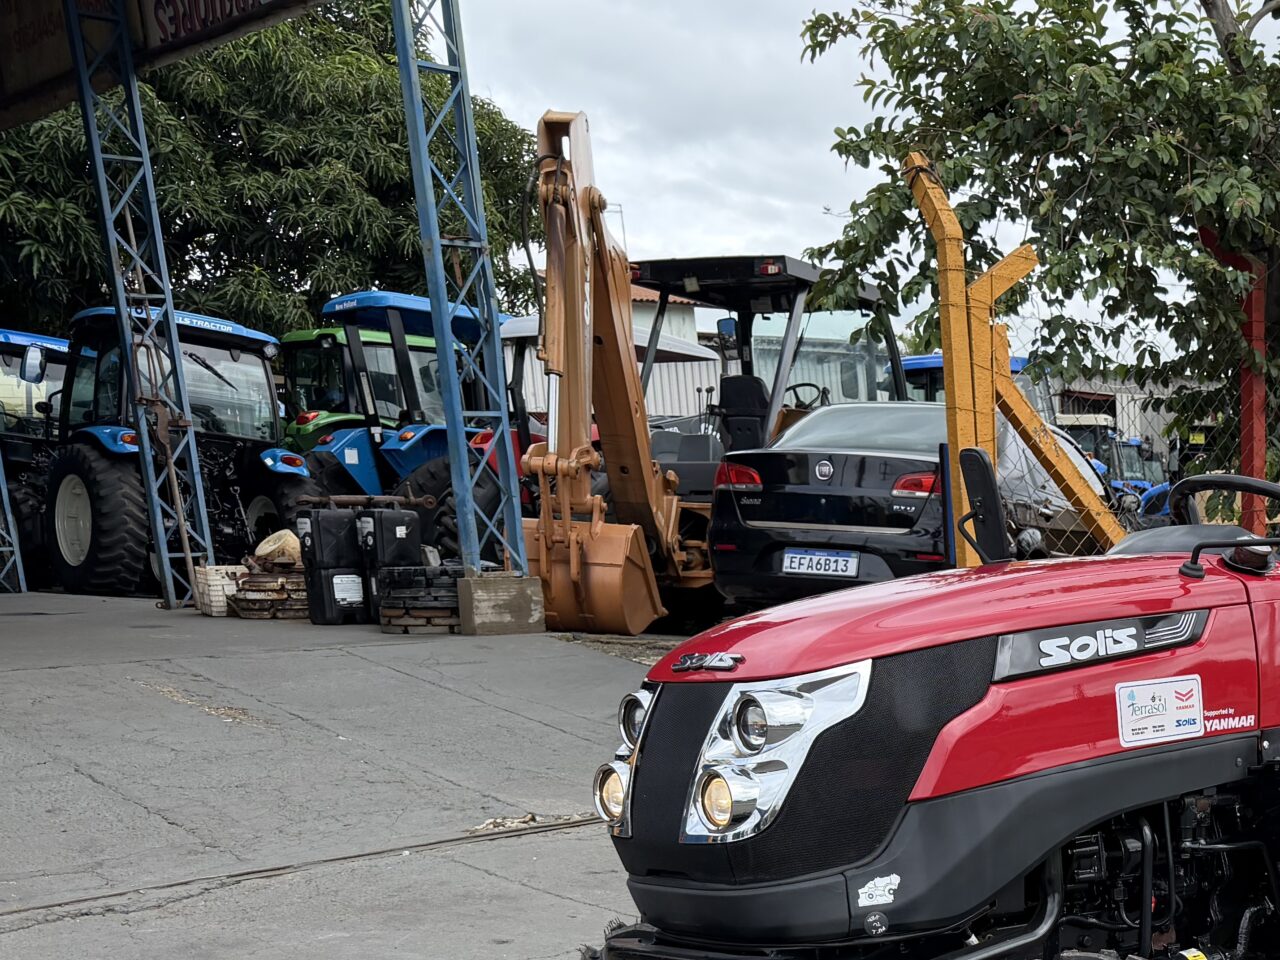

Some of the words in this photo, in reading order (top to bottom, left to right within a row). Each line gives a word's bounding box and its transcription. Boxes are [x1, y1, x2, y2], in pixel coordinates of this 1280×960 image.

[178, 316, 191, 326] LS
[192, 319, 233, 333] TRACTOR
[789, 556, 849, 573] EFA6B13
[1203, 709, 1228, 717] Supported
[1228, 707, 1235, 715] by
[1204, 714, 1255, 732] YANMAR
